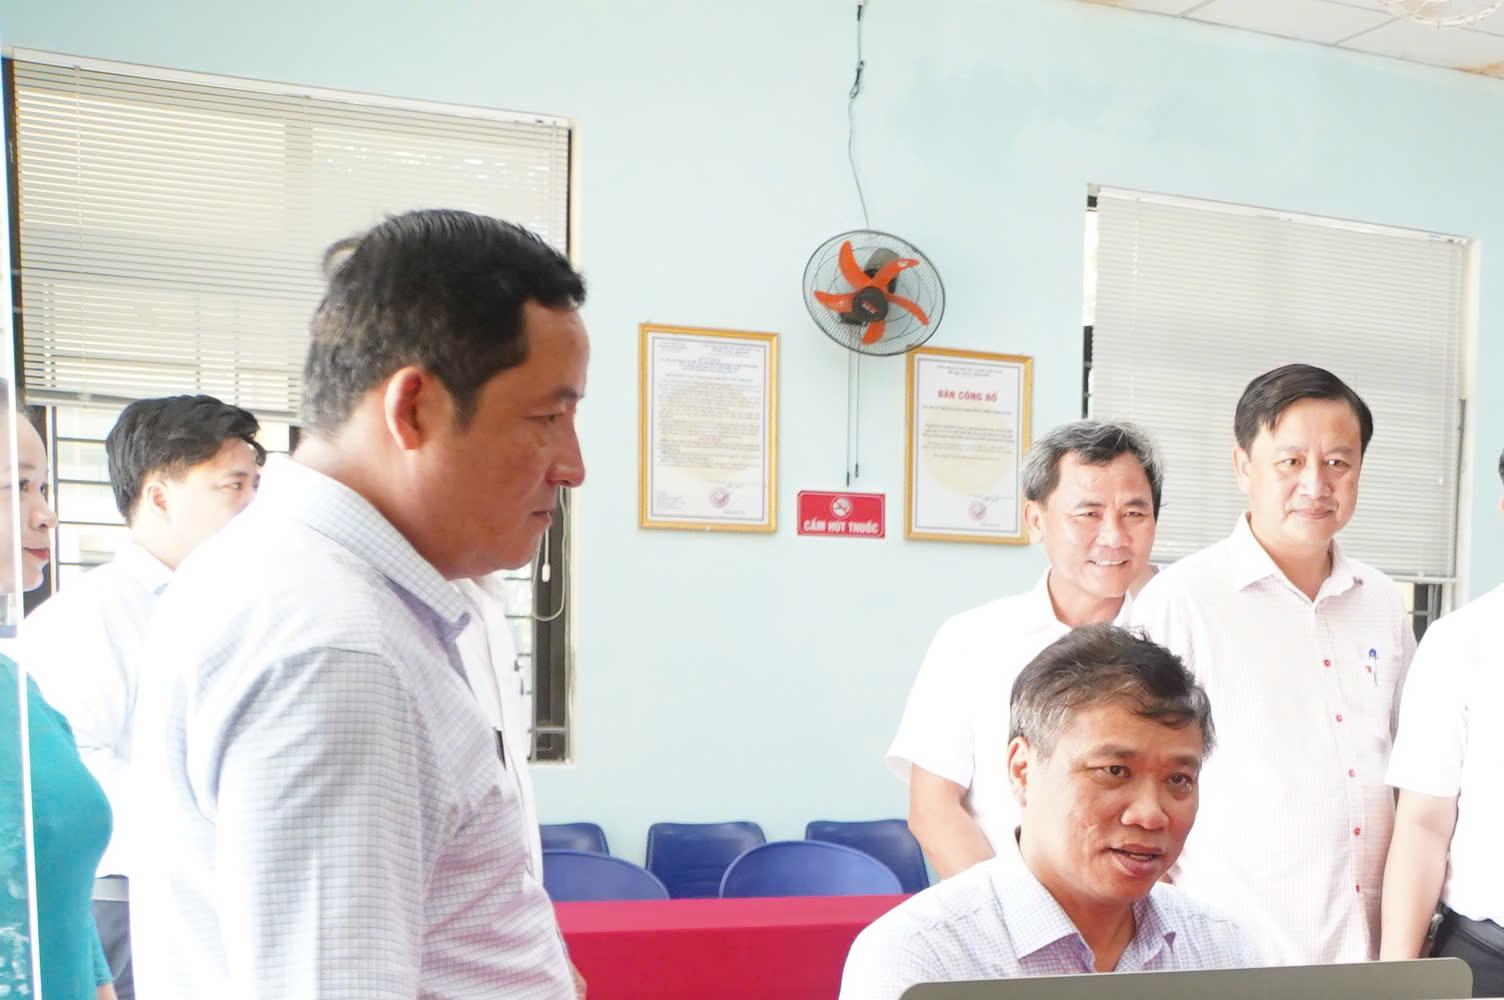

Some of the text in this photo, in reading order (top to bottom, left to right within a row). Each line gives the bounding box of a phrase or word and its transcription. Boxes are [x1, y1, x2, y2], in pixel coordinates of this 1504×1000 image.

[803, 517, 879, 534] CẤM HÚT THUỐC
